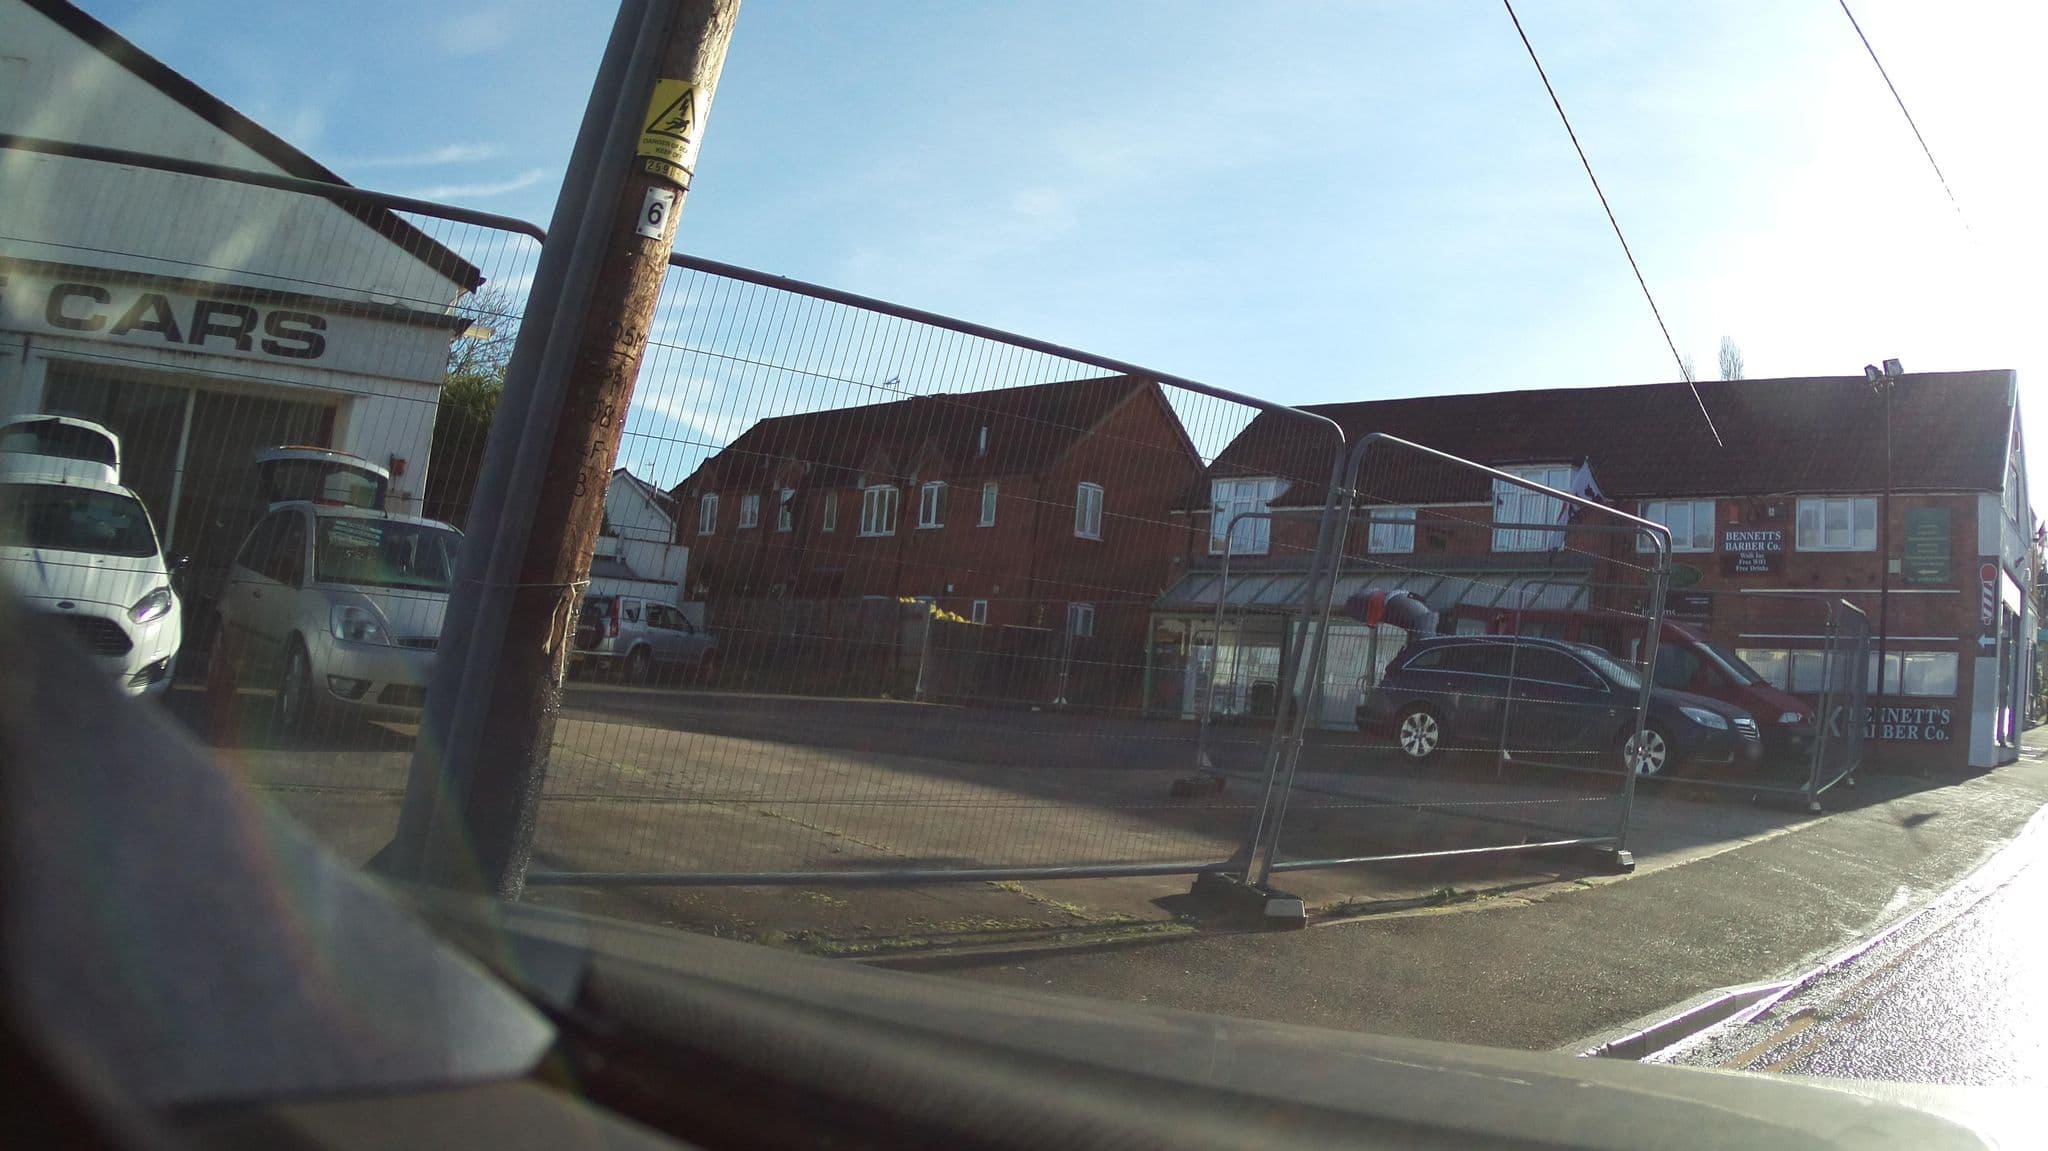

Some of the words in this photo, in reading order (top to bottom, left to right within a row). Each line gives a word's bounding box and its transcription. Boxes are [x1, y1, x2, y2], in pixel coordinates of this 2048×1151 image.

[647, 202, 665, 225] 6
[45, 282, 328, 361] CARS
[1725, 541, 1765, 551] BARBER
[1767, 541, 1781, 551] Co.
[1924, 724, 1950, 741] Co.
